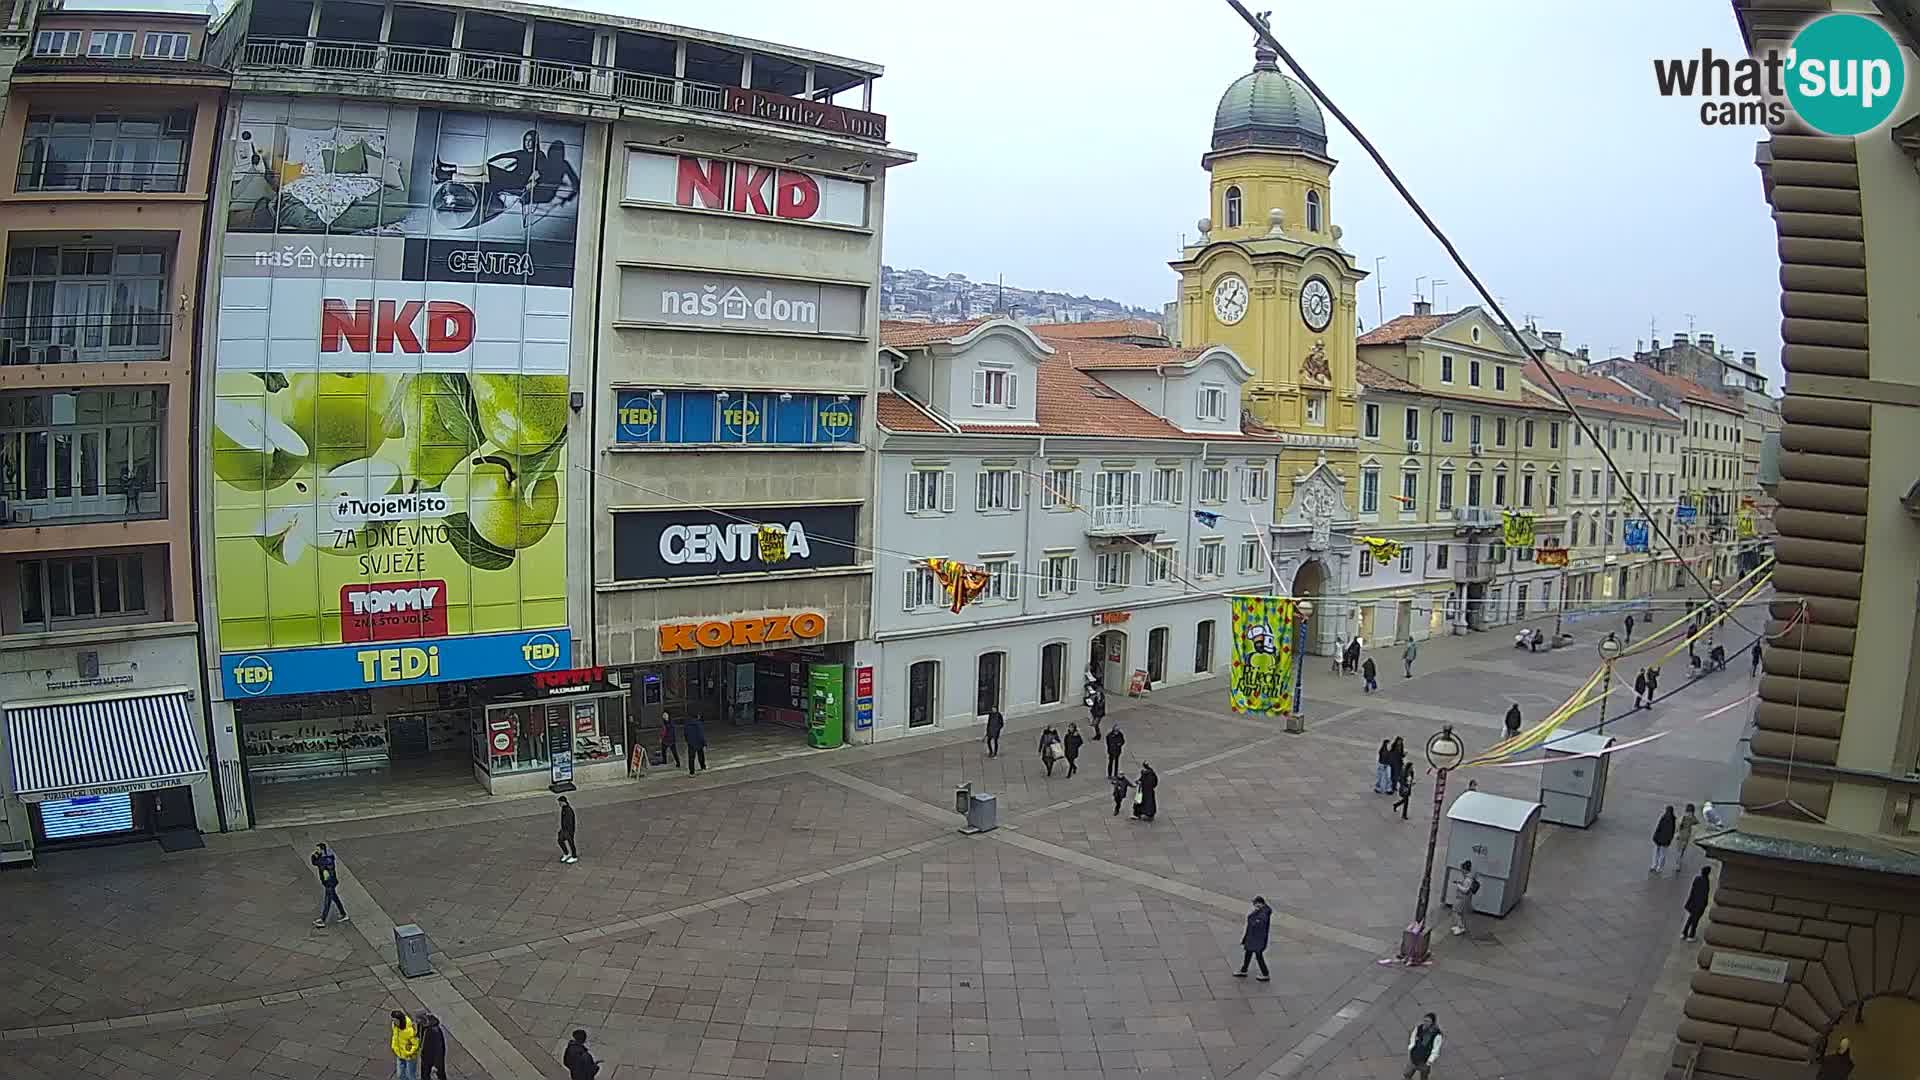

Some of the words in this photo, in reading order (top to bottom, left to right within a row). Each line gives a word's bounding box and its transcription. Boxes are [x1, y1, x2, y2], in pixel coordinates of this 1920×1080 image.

[723, 88, 745, 112] Le
[676, 157, 820, 219] NKD
[255, 246, 294, 268] naš
[319, 247, 365, 269] dom
[448, 250, 534, 276] CENTRA
[661, 283, 718, 317] naš
[753, 290, 816, 323] dom
[320, 298, 477, 354] NKD
[619, 408, 657, 425] TEDi
[724, 409, 760, 426] TEDi
[820, 411, 853, 427] TEDi
[338, 497, 446, 516] #TvojeMisto
[334, 528, 357, 549] ZA
[366, 524, 450, 549] DNEVNO
[659, 521, 810, 564] CENTA
[359, 548, 425, 575] SVJEŽE
[348, 587, 440, 615] TOMMY
[659, 613, 825, 653] KORZO
[358, 646, 439, 682] TEDi
[522, 642, 560, 661] TEDi
[233, 667, 273, 684] TEDi
